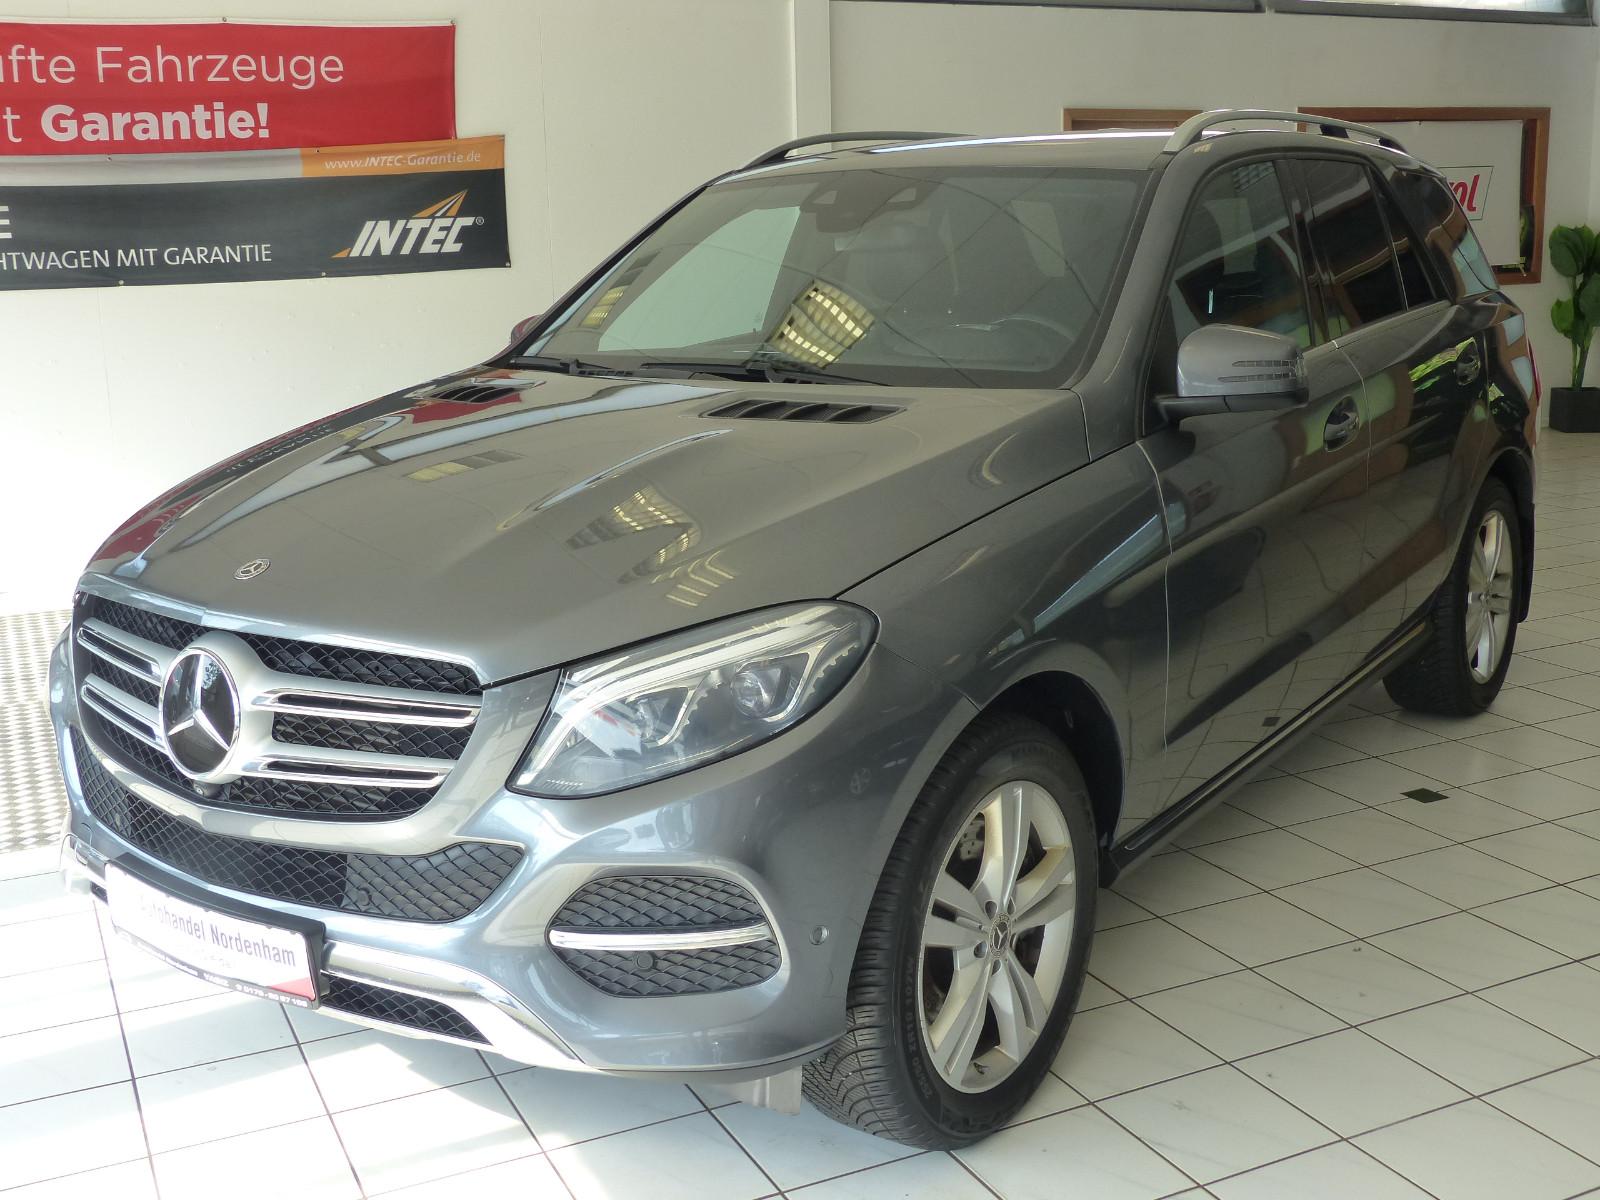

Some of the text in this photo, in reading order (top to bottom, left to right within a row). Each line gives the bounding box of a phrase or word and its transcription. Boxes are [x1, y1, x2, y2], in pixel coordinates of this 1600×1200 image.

[96, 44, 345, 90] Fahrzeuge
[40, 101, 271, 142] Garantie!
[323, 150, 482, 170] www.INTEC-Garantie.de
[1449, 173, 1481, 212] ol
[116, 248, 158, 267] MIT
[163, 243, 273, 266] GARANTIE
[139, 896, 206, 942] ohandel
[210, 922, 297, 967] Nordenham
